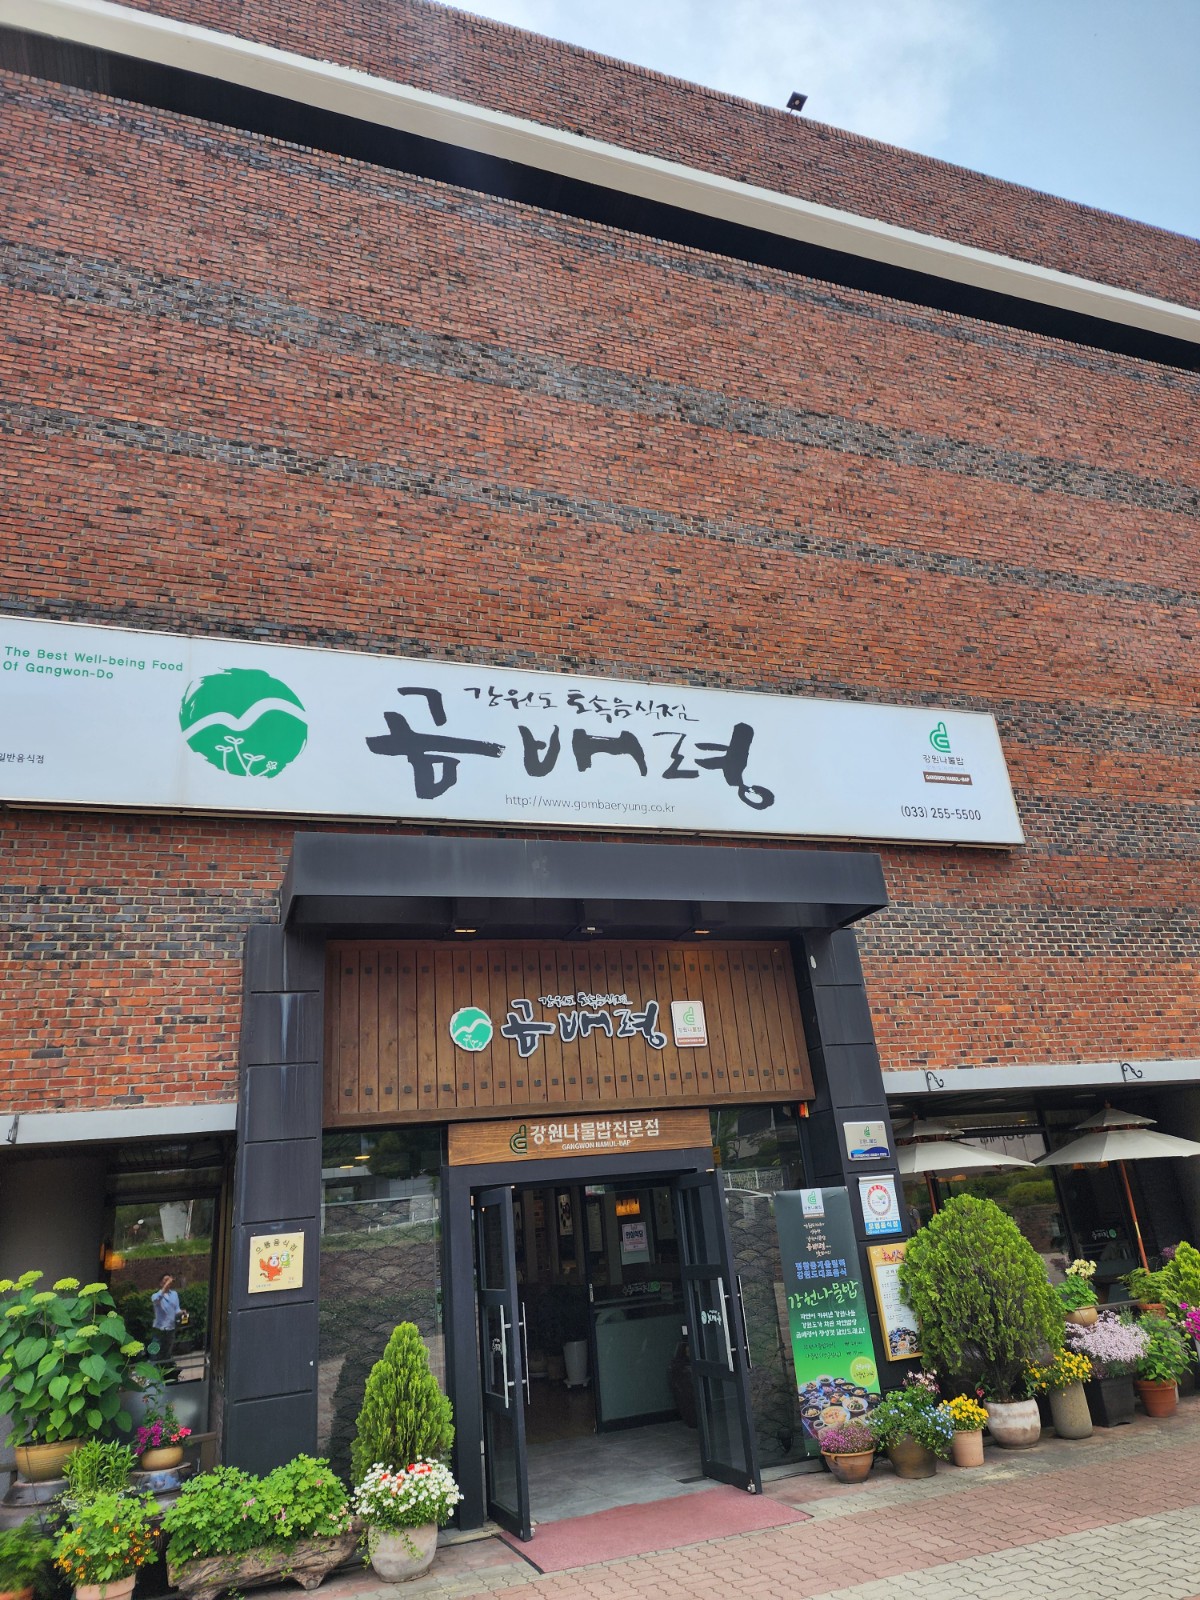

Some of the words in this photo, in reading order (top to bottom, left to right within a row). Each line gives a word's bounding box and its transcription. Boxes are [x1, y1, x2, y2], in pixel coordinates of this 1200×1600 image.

[3, 660, 18, 671] Of
[25, 663, 114, 679] Gangwon-Do
[5, 646, 30, 658] The
[37, 649, 68, 661] Best
[74, 652, 146, 670] Well-being
[152, 660, 183, 672] Food
[464, 685, 558, 709] 강원도
[365, 687, 776, 810] 곰배령
[922, 754, 964, 766] 강원나물밥
[504, 793, 676, 815] http://www.gombaeryung.co.kr
[901, 805, 928, 818] (033)
[930, 807, 982, 821] 255-5500
[500, 998, 668, 1058] 곰배령
[530, 1118, 660, 1145] 강원나물밥전문점
[562, 1141, 595, 1151] GANGWON
[788, 1280, 859, 1309] 강원나물밥
